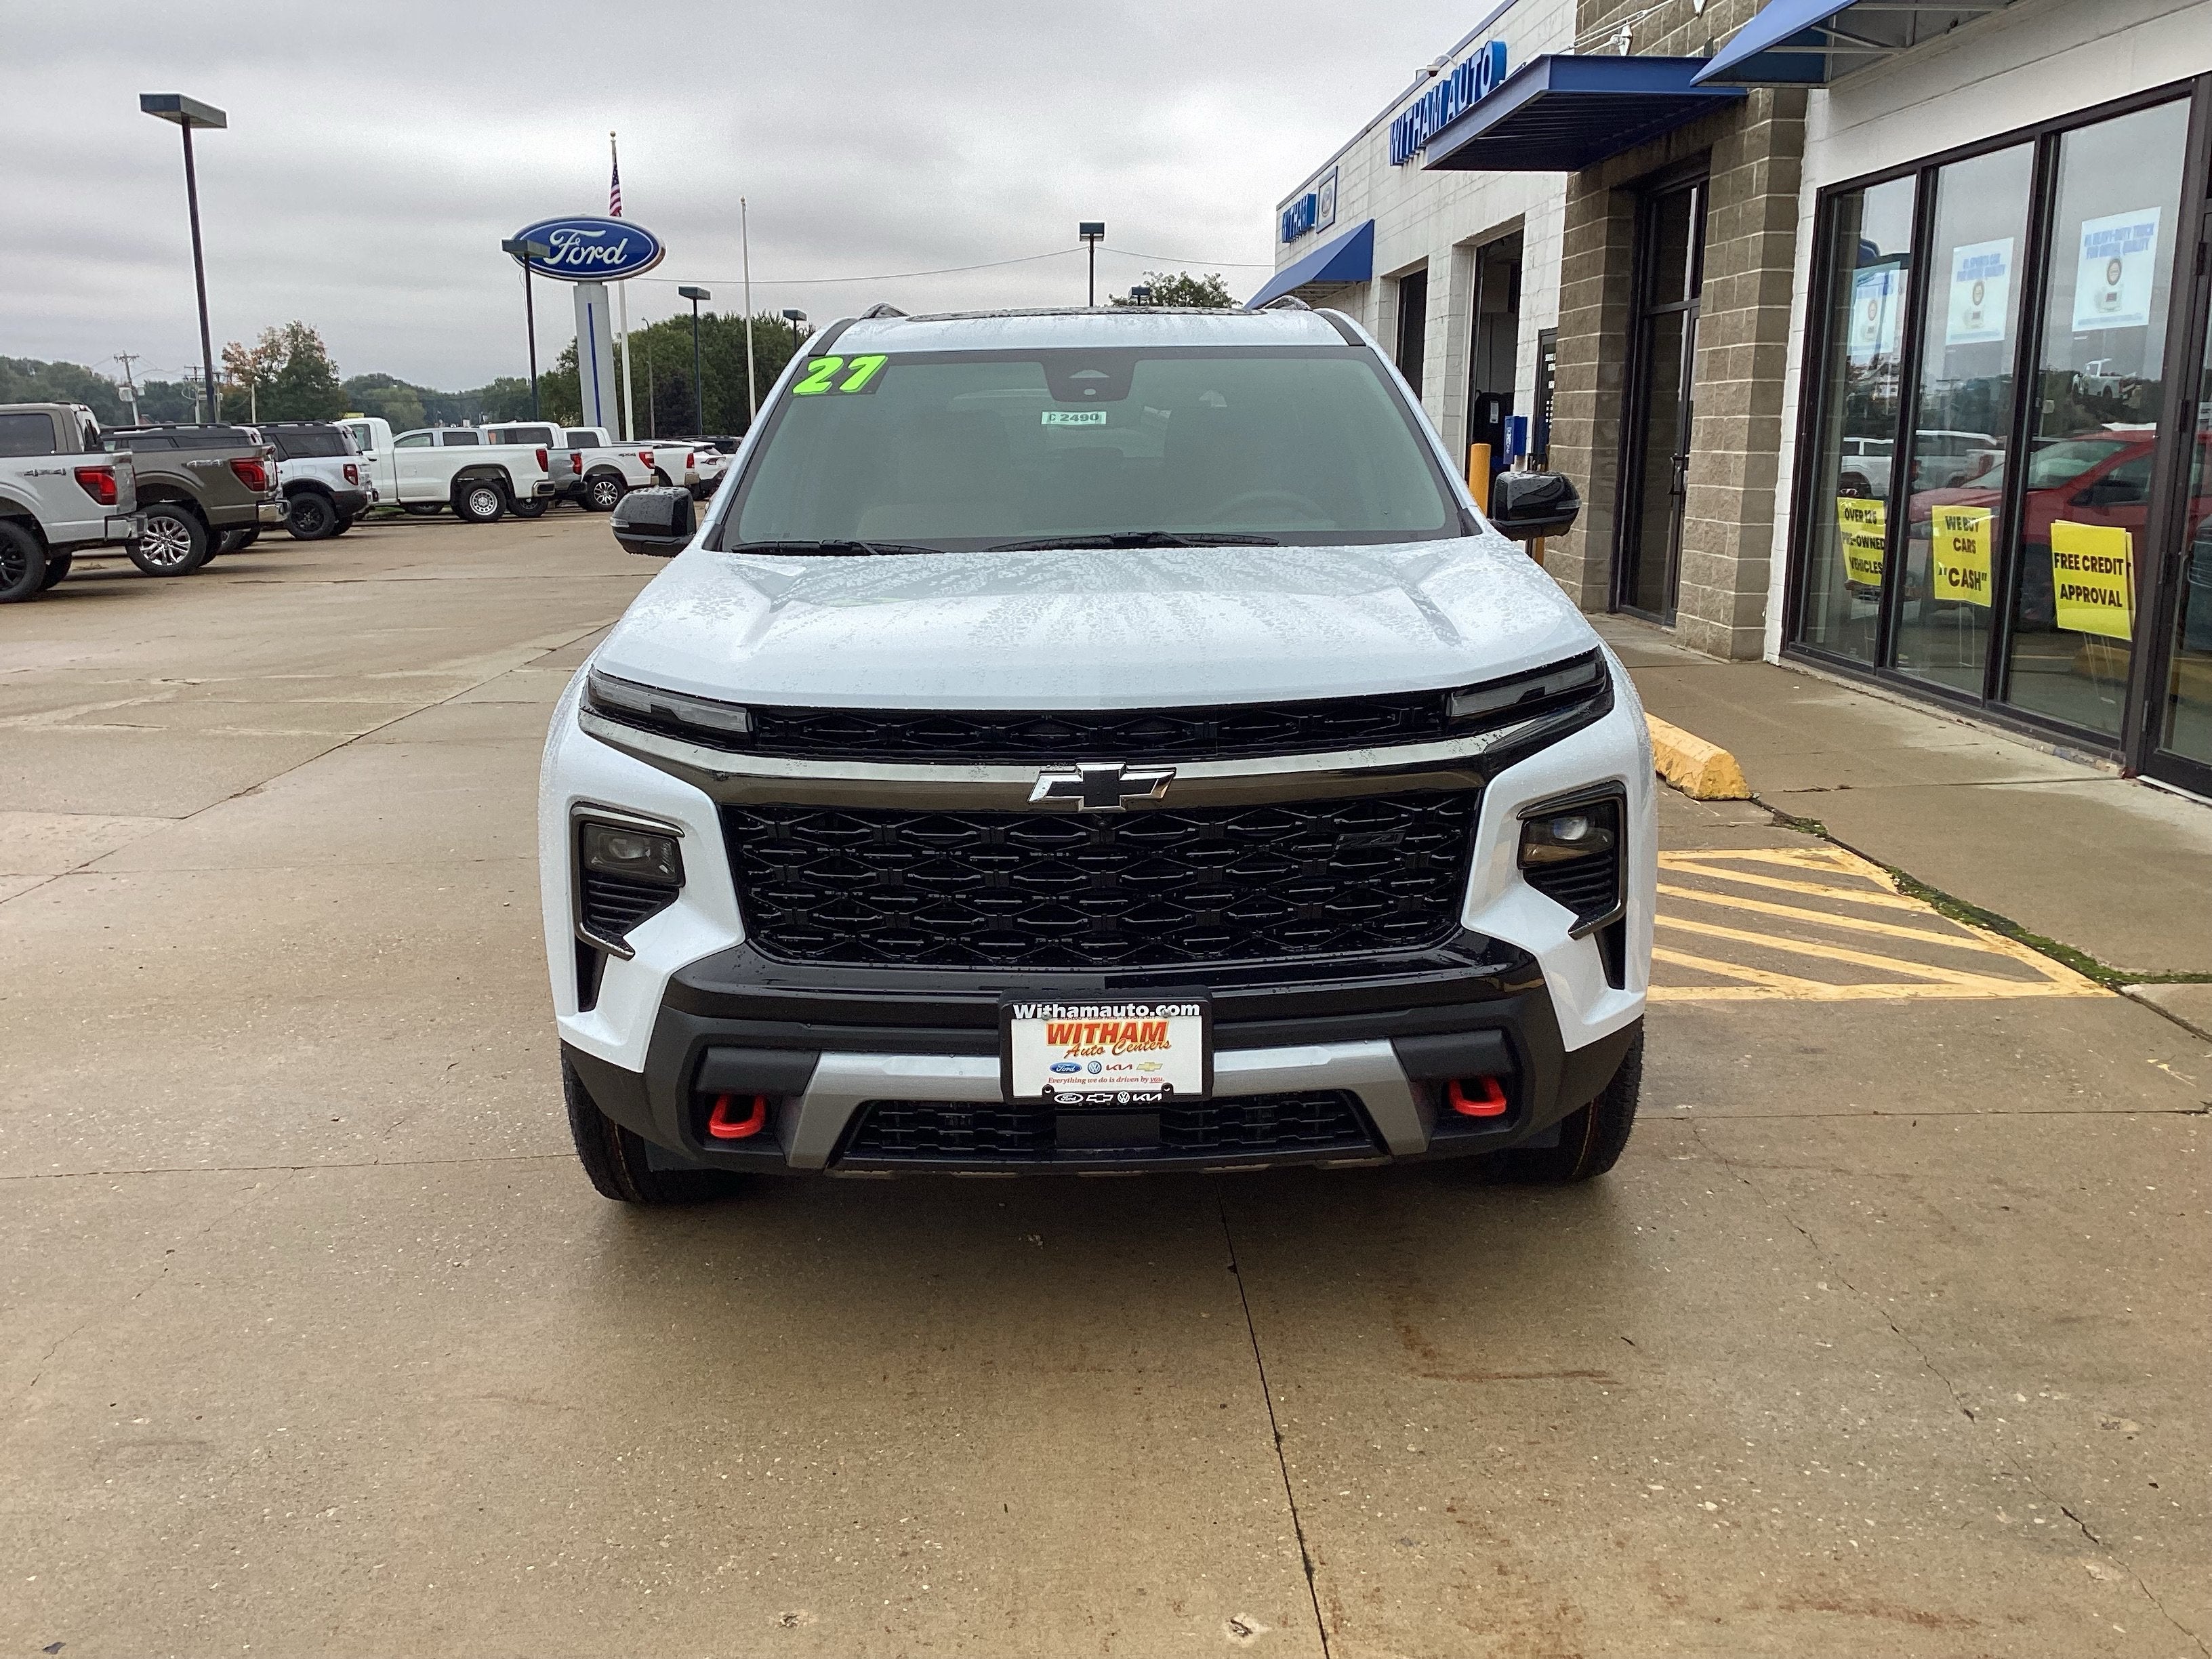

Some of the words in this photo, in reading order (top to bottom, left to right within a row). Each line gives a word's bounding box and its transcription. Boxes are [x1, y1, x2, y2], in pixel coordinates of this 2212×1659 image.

[1390, 79, 1450, 166] WITHAM
[1446, 40, 1507, 125] AUTO
[543, 228, 629, 265] Ford
[792, 354, 889, 396] 27
[1060, 413, 1099, 422] 2490
[1844, 508, 1864, 523] OVER
[1944, 515, 1963, 531] WE
[1952, 537, 1977, 554] CARS
[1849, 556, 1883, 575] VEHICLES
[2054, 552, 2081, 571] FREE
[2082, 554, 2124, 575] CREDIT
[1938, 567, 1988, 591] "CASH"
[2060, 583, 2123, 608] APPROVAL
[1013, 1003, 1200, 1019] Withamauto.com
[1046, 1021, 1170, 1046] WITHAM
[1063, 1042, 1105, 1059] Auto
[1111, 1039, 1172, 1056] Centers
[1141, 1076, 1149, 1084] by
